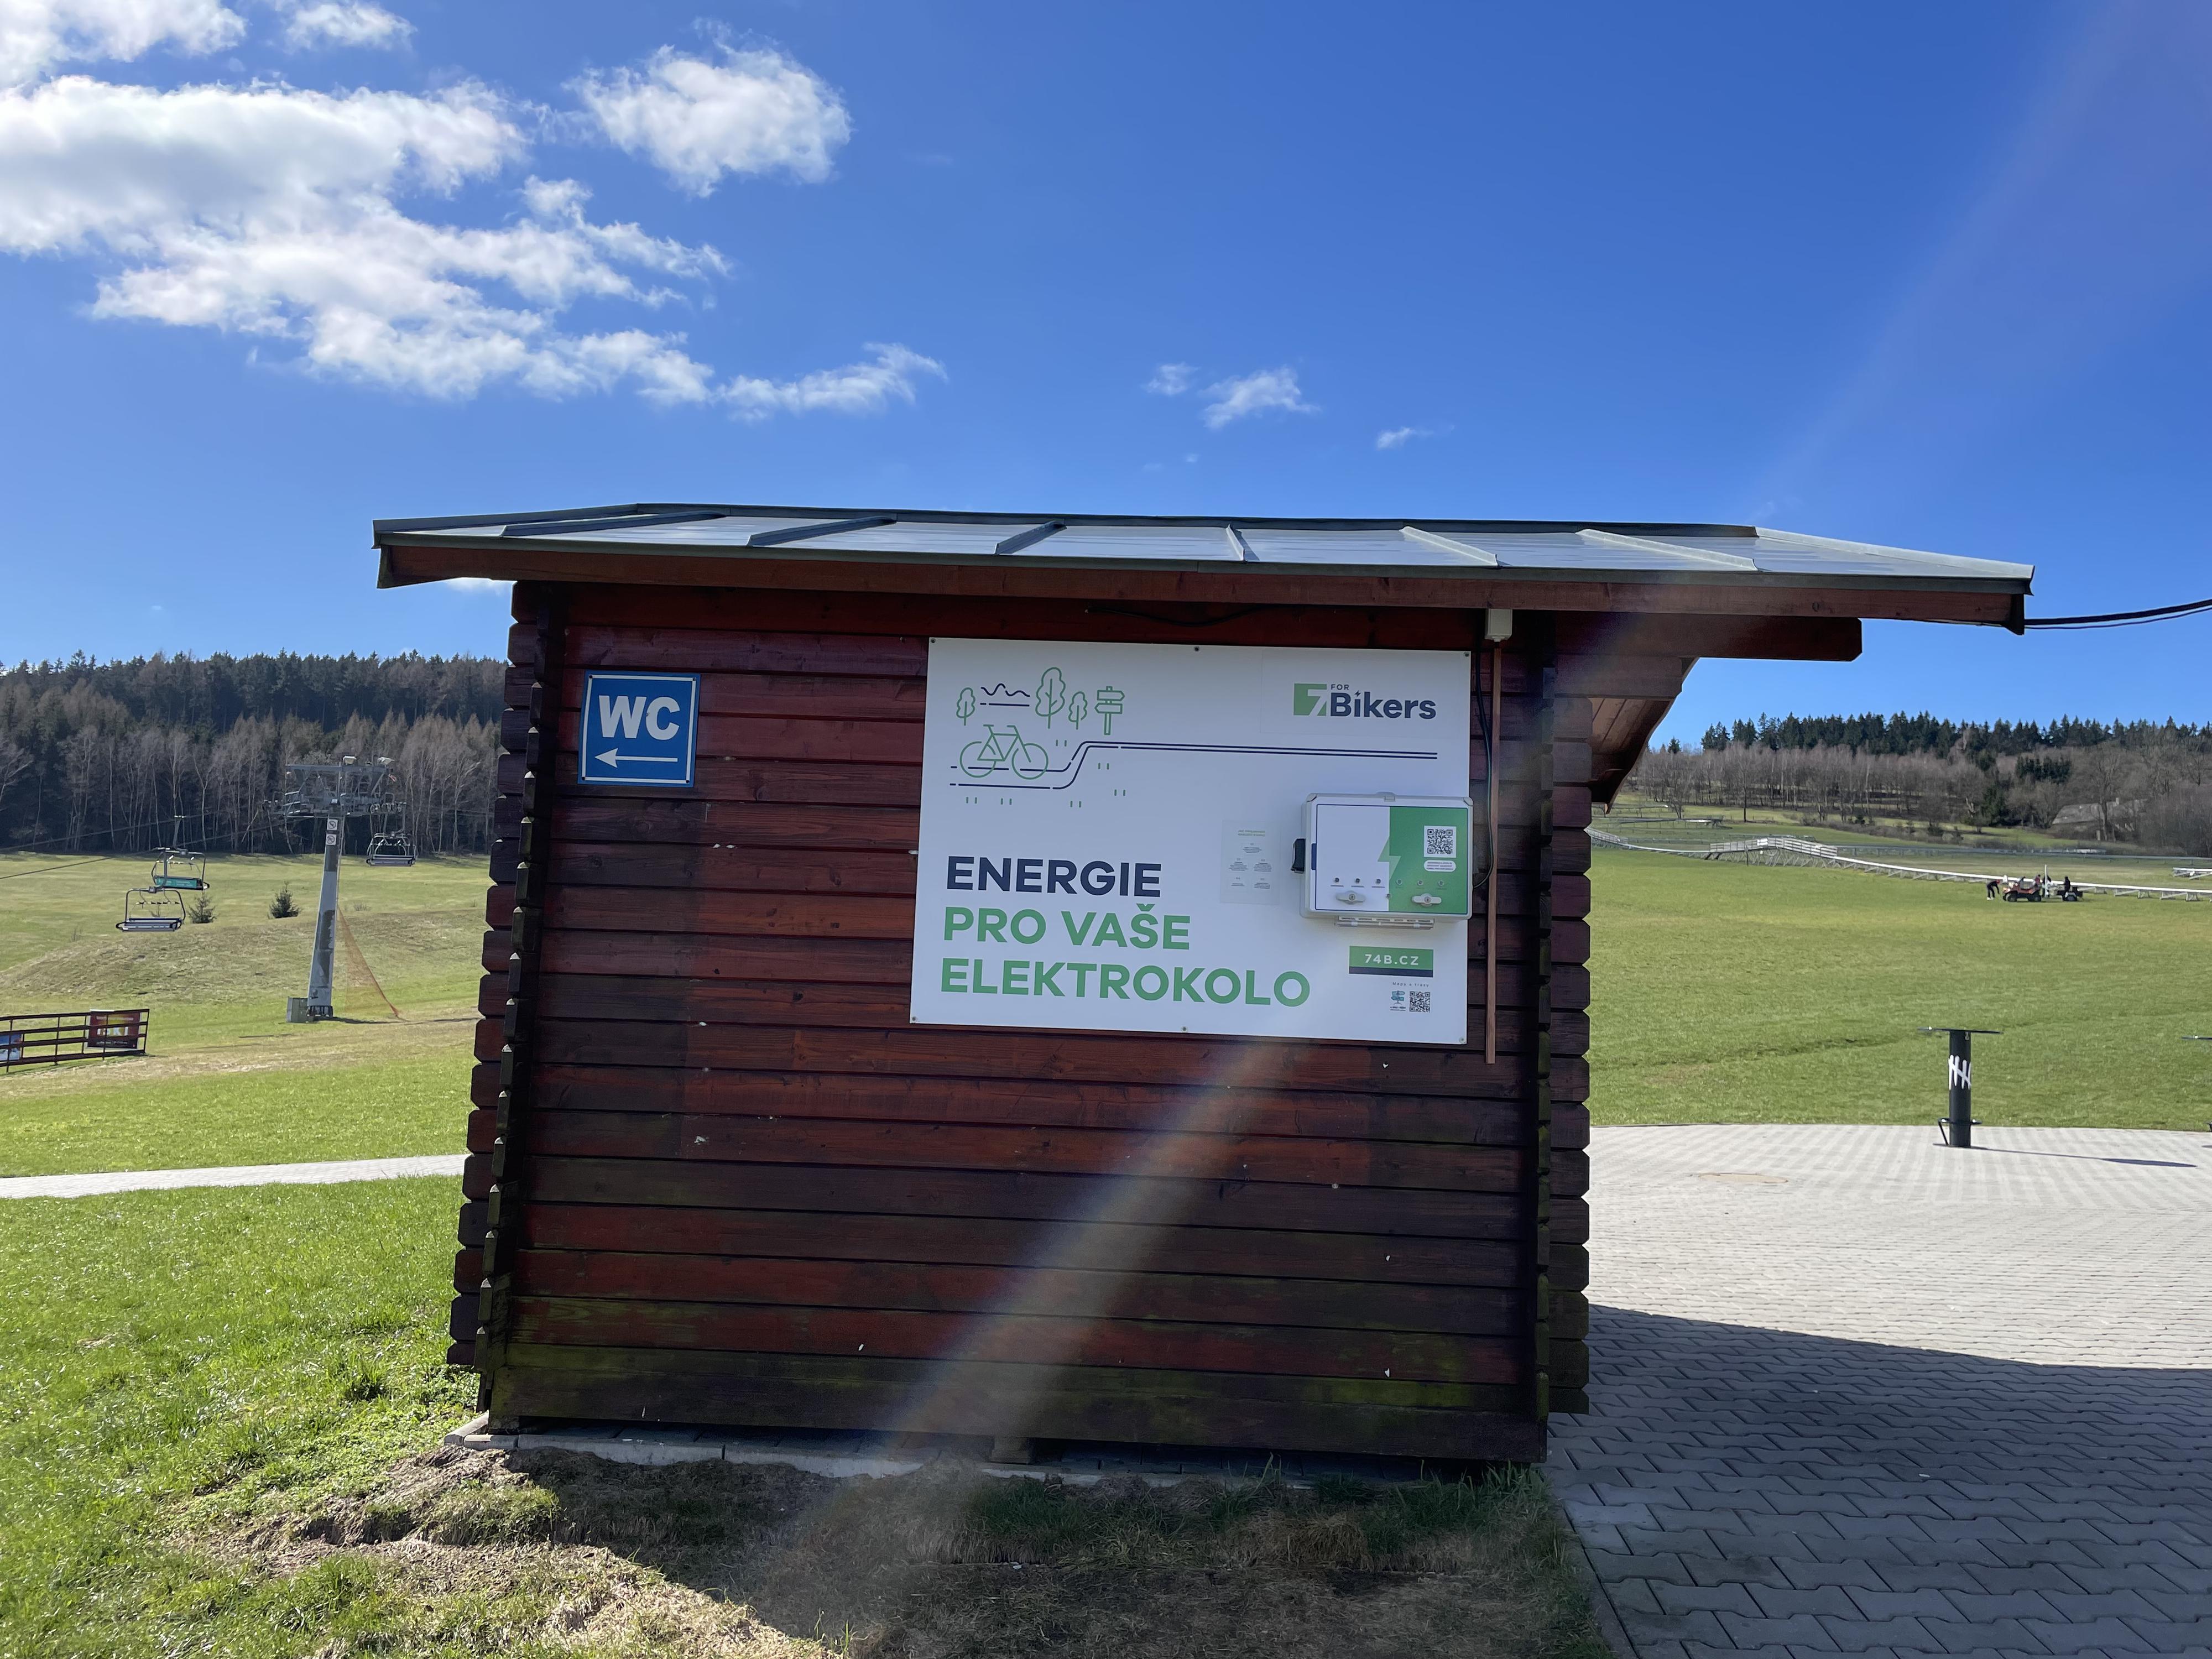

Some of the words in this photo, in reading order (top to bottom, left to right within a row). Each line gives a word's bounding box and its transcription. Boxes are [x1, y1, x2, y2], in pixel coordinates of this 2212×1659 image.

[598, 695, 680, 740] WC
[1331, 690, 1436, 719] Bikers
[947, 856, 1161, 898] ENERGIE
[944, 906, 1046, 945] PRO
[1061, 903, 1190, 950] VAŠE
[1365, 953, 1419, 966] 74B.CZ
[941, 958, 1310, 1007] ELEKTROKOLO
